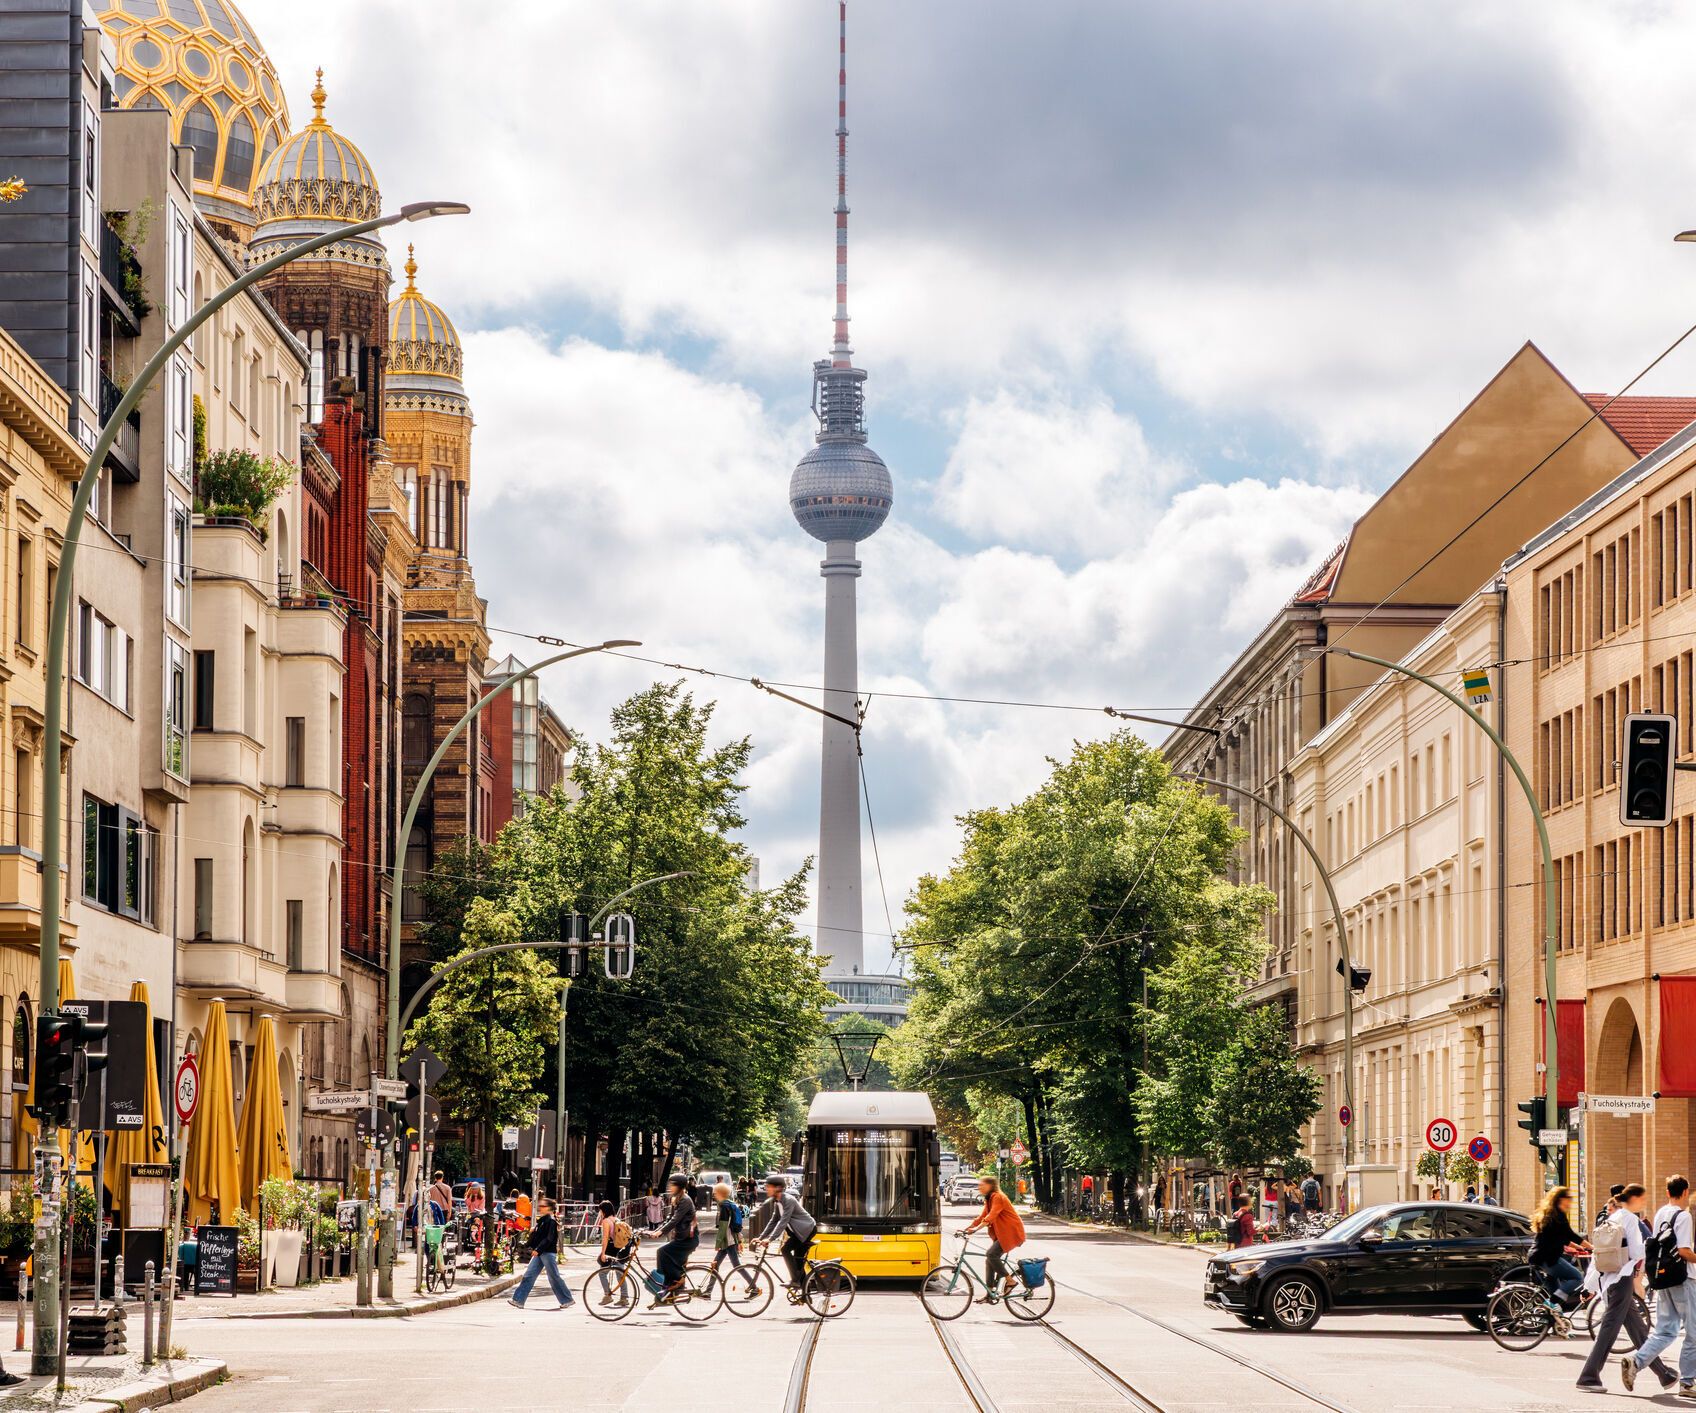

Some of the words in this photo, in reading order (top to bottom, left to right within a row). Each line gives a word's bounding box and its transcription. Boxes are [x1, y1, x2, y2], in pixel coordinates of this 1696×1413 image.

[1473, 694, 1489, 704] LZA
[73, 1006, 87, 1014] AVS
[316, 1095, 362, 1105] Tucholskystraße
[1592, 1099, 1651, 1110] Tucholskystraße
[1432, 1127, 1451, 1142] 30
[137, 1168, 164, 1176] BREAKFAST
